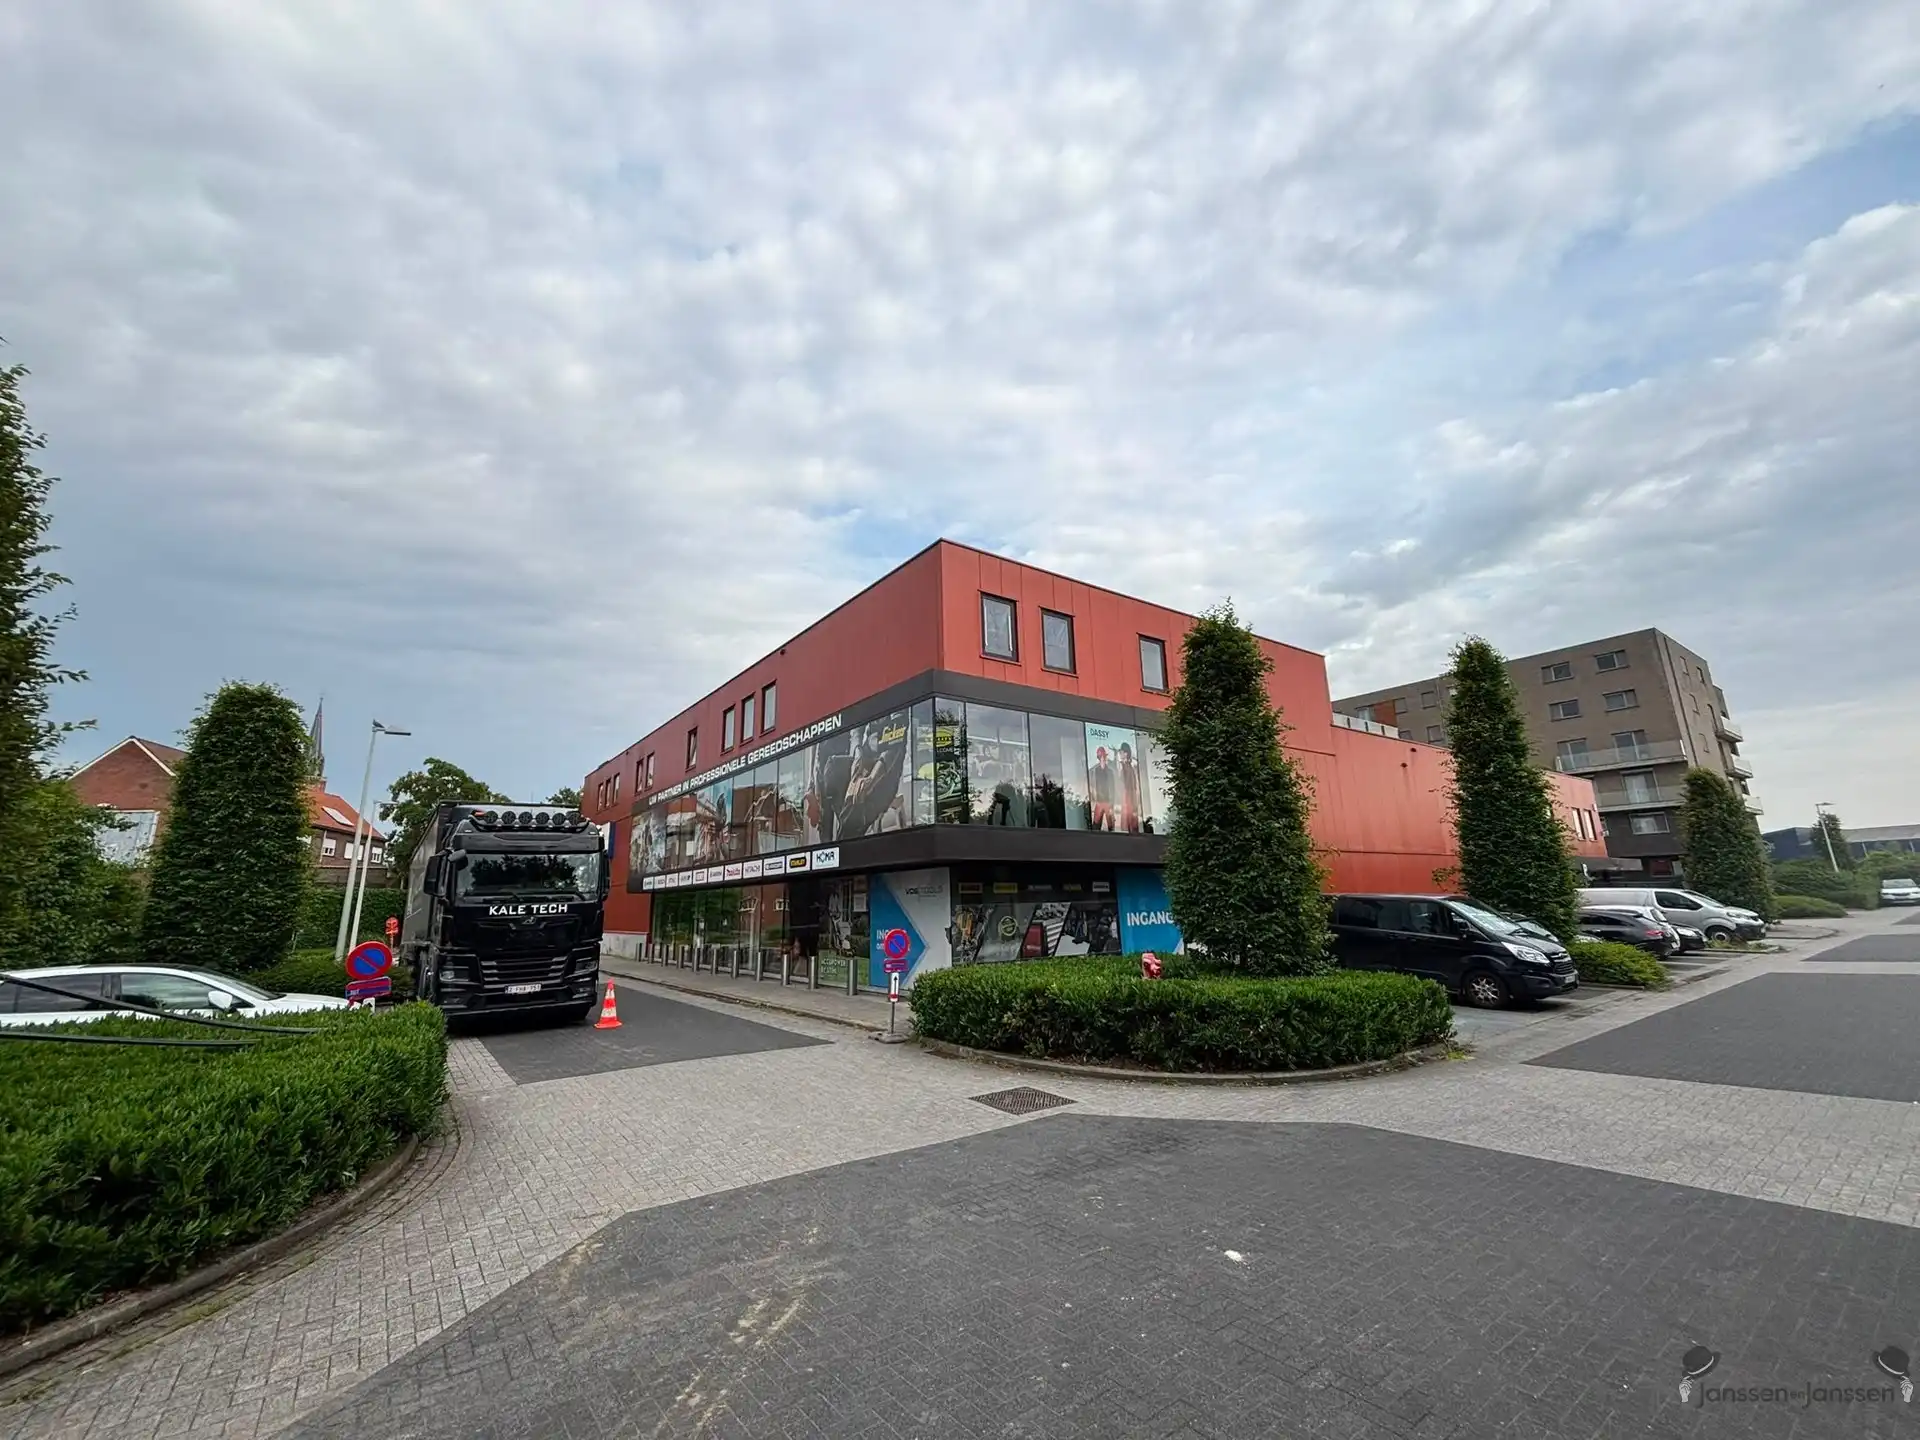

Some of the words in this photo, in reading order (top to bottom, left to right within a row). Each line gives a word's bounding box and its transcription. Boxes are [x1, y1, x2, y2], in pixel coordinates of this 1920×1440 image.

[1089, 728, 1109, 739] DASSY
[657, 783, 682, 802] PARTNER
[682, 780, 689, 791] IN
[689, 757, 746, 788] PROFESSIONELE
[747, 713, 842, 764] GEREEDSCHAPPEN
[489, 905, 526, 916] KALE
[531, 904, 568, 914] TECH
